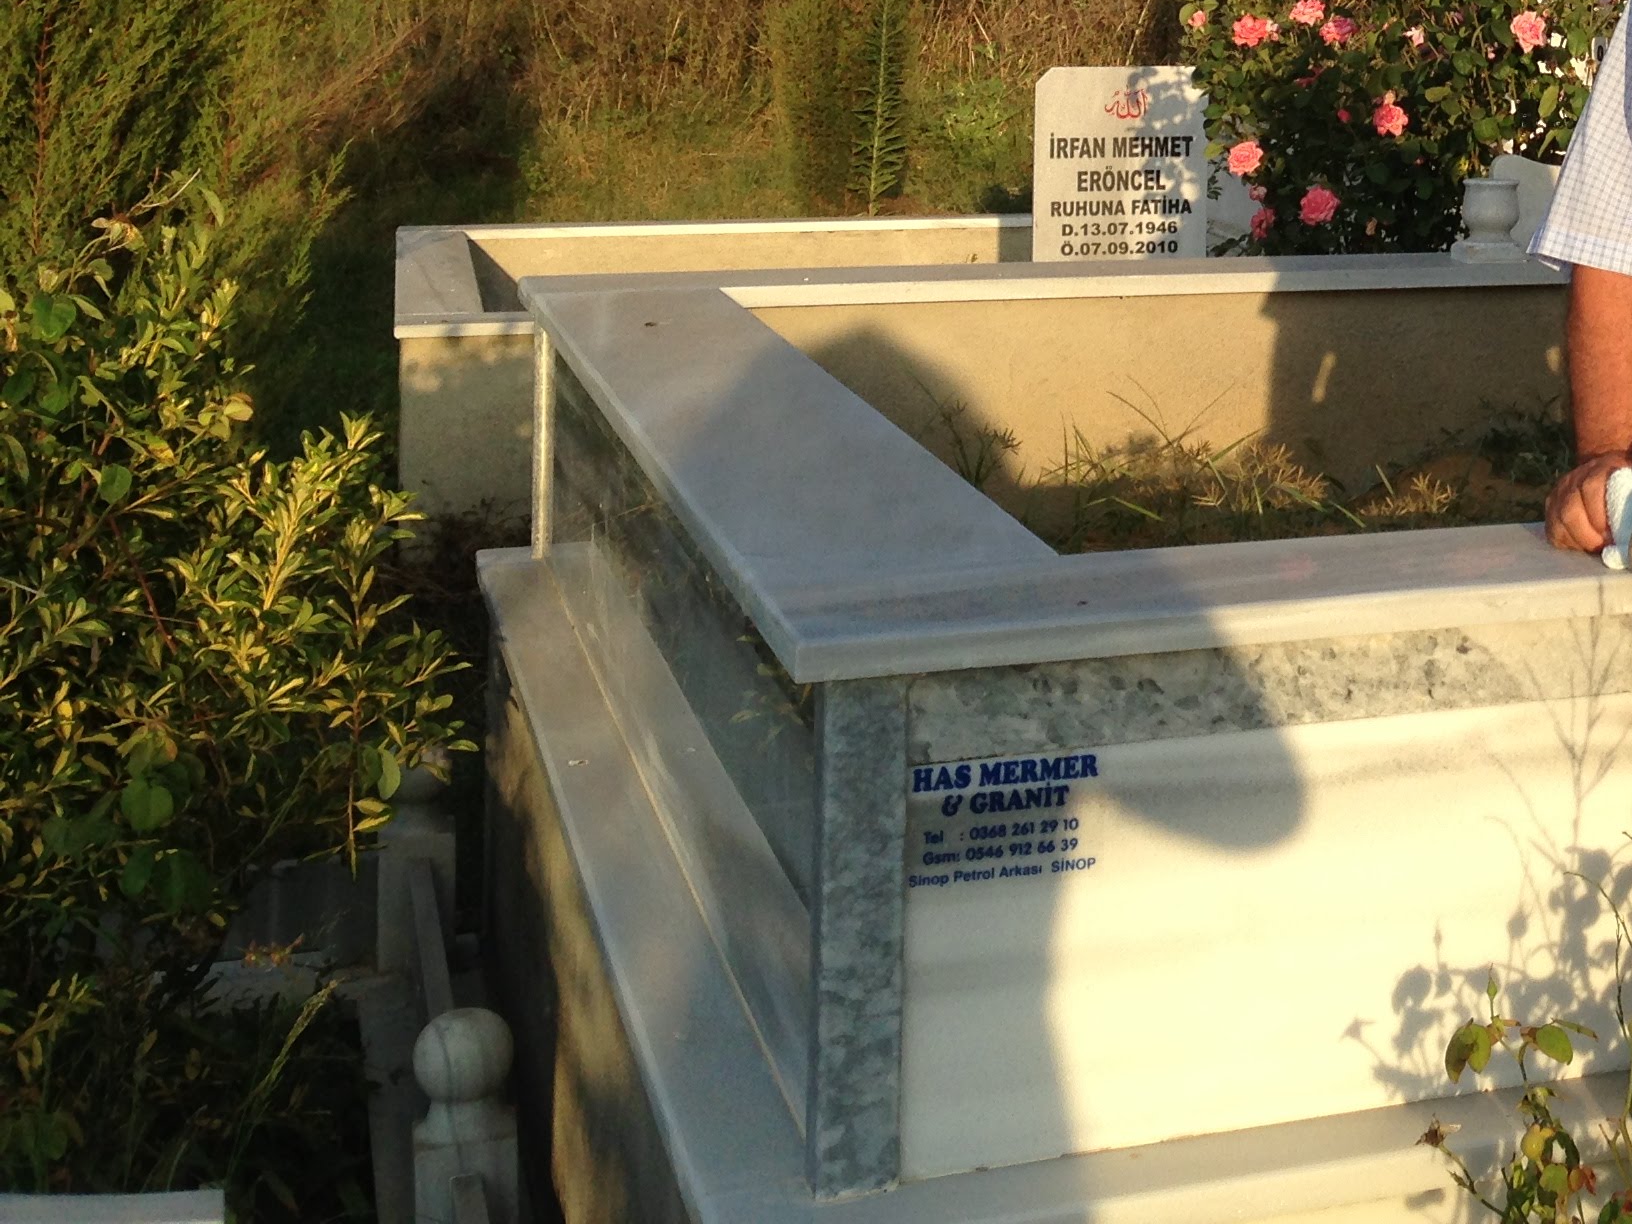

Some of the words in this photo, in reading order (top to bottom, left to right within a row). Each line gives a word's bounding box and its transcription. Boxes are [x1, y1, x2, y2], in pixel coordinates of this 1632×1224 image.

[1049, 132, 1105, 159] İRFAN
[1112, 136, 1193, 158] MEHMET
[1077, 166, 1166, 192] ERÖNCEL
[1050, 200, 1125, 217] RUHUNA
[1131, 195, 1192, 215] FATİHA
[1062, 221, 1178, 236] D.13.07.1946
[1061, 240, 1178, 255] Ö.07.09.2010
[912, 764, 972, 793] HAS
[979, 754, 1098, 787] MERMER
[942, 794, 963, 816] &
[969, 783, 1070, 814] GRANİT
[923, 831, 944, 845] Tel
[969, 825, 1007, 841] 0368
[1011, 822, 1035, 836] 261
[1040, 820, 1059, 832] 29
[1063, 818, 1079, 830] 10
[923, 851, 960, 866] Gsm:
[966, 845, 1004, 861] 0546
[1009, 842, 1032, 856] 912
[1037, 840, 1055, 853] 66
[1061, 838, 1078, 851] 39
[909, 874, 949, 888] Sinop
[954, 868, 994, 883] Petrol
[999, 864, 1042, 878] Arkası
[1051, 857, 1096, 873] SİNOP
